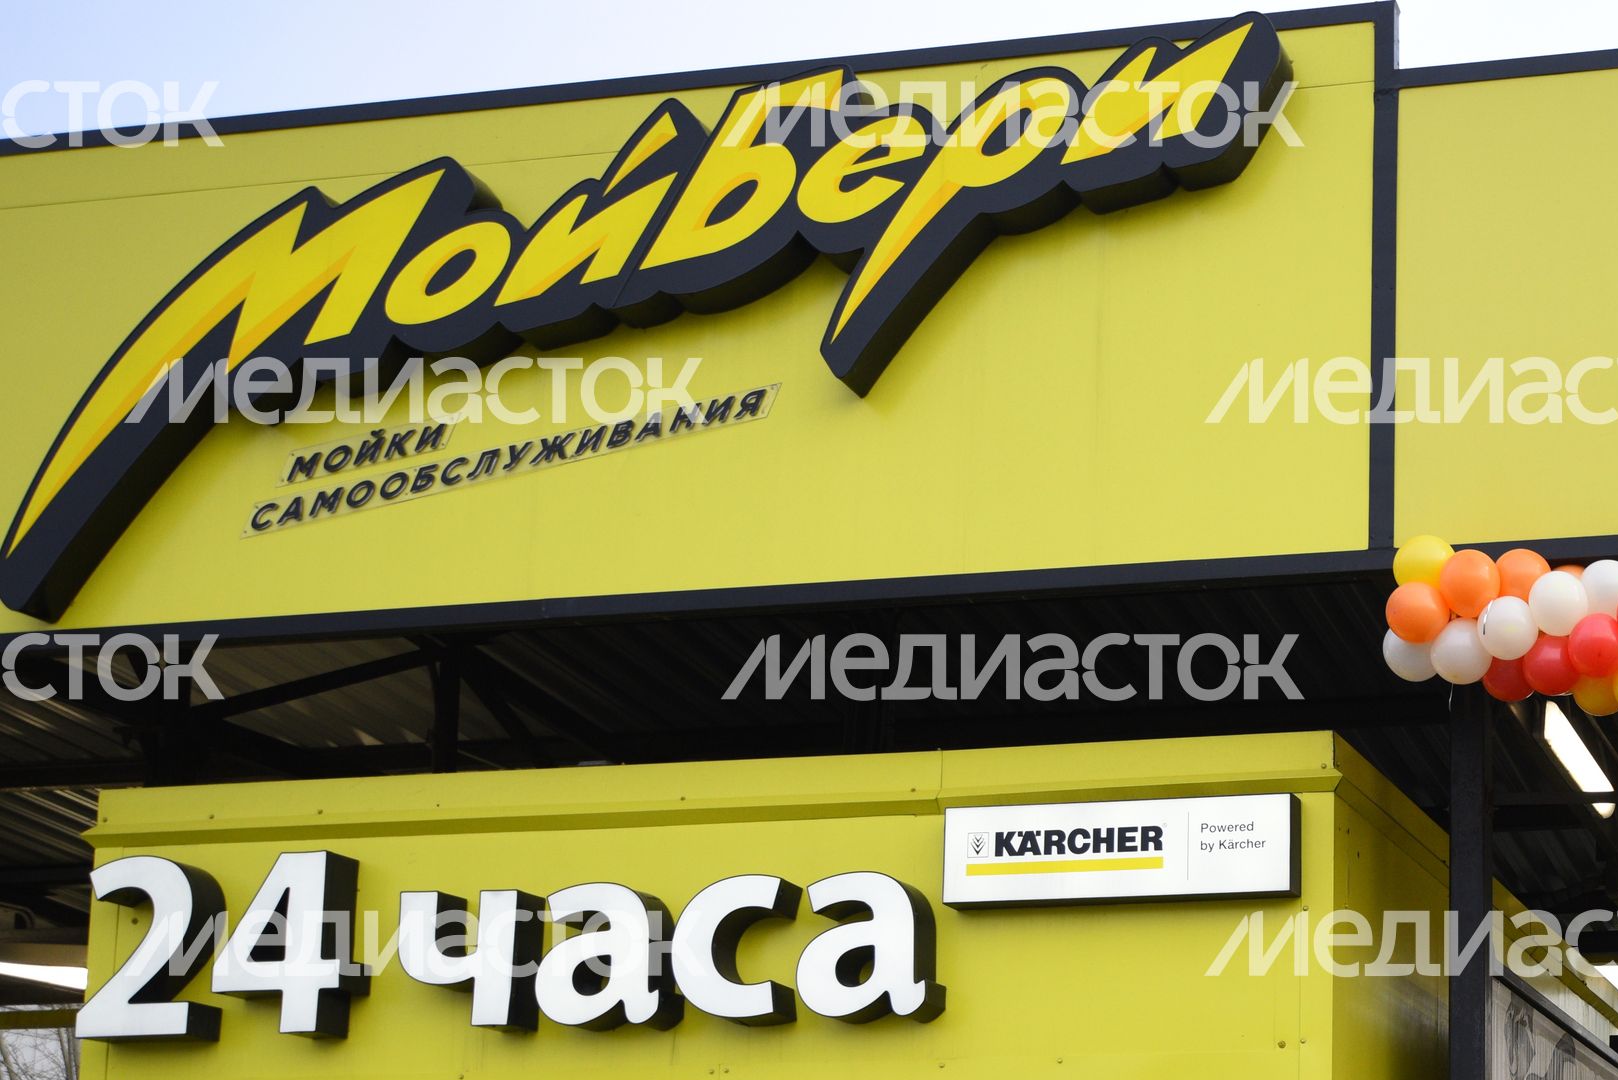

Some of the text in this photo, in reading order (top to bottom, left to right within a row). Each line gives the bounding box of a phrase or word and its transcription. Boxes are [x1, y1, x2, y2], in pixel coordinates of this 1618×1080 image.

[250, 388, 769, 534] САМООБСЛУЖИВАНИЯ
[288, 421, 446, 485] МОЙКИ
[994, 825, 1164, 857] KÄRCHER
[1200, 821, 1254, 834] Powered
[1200, 838, 1266, 852] by Kärcher
[75, 850, 938, 1041] 24 часа
